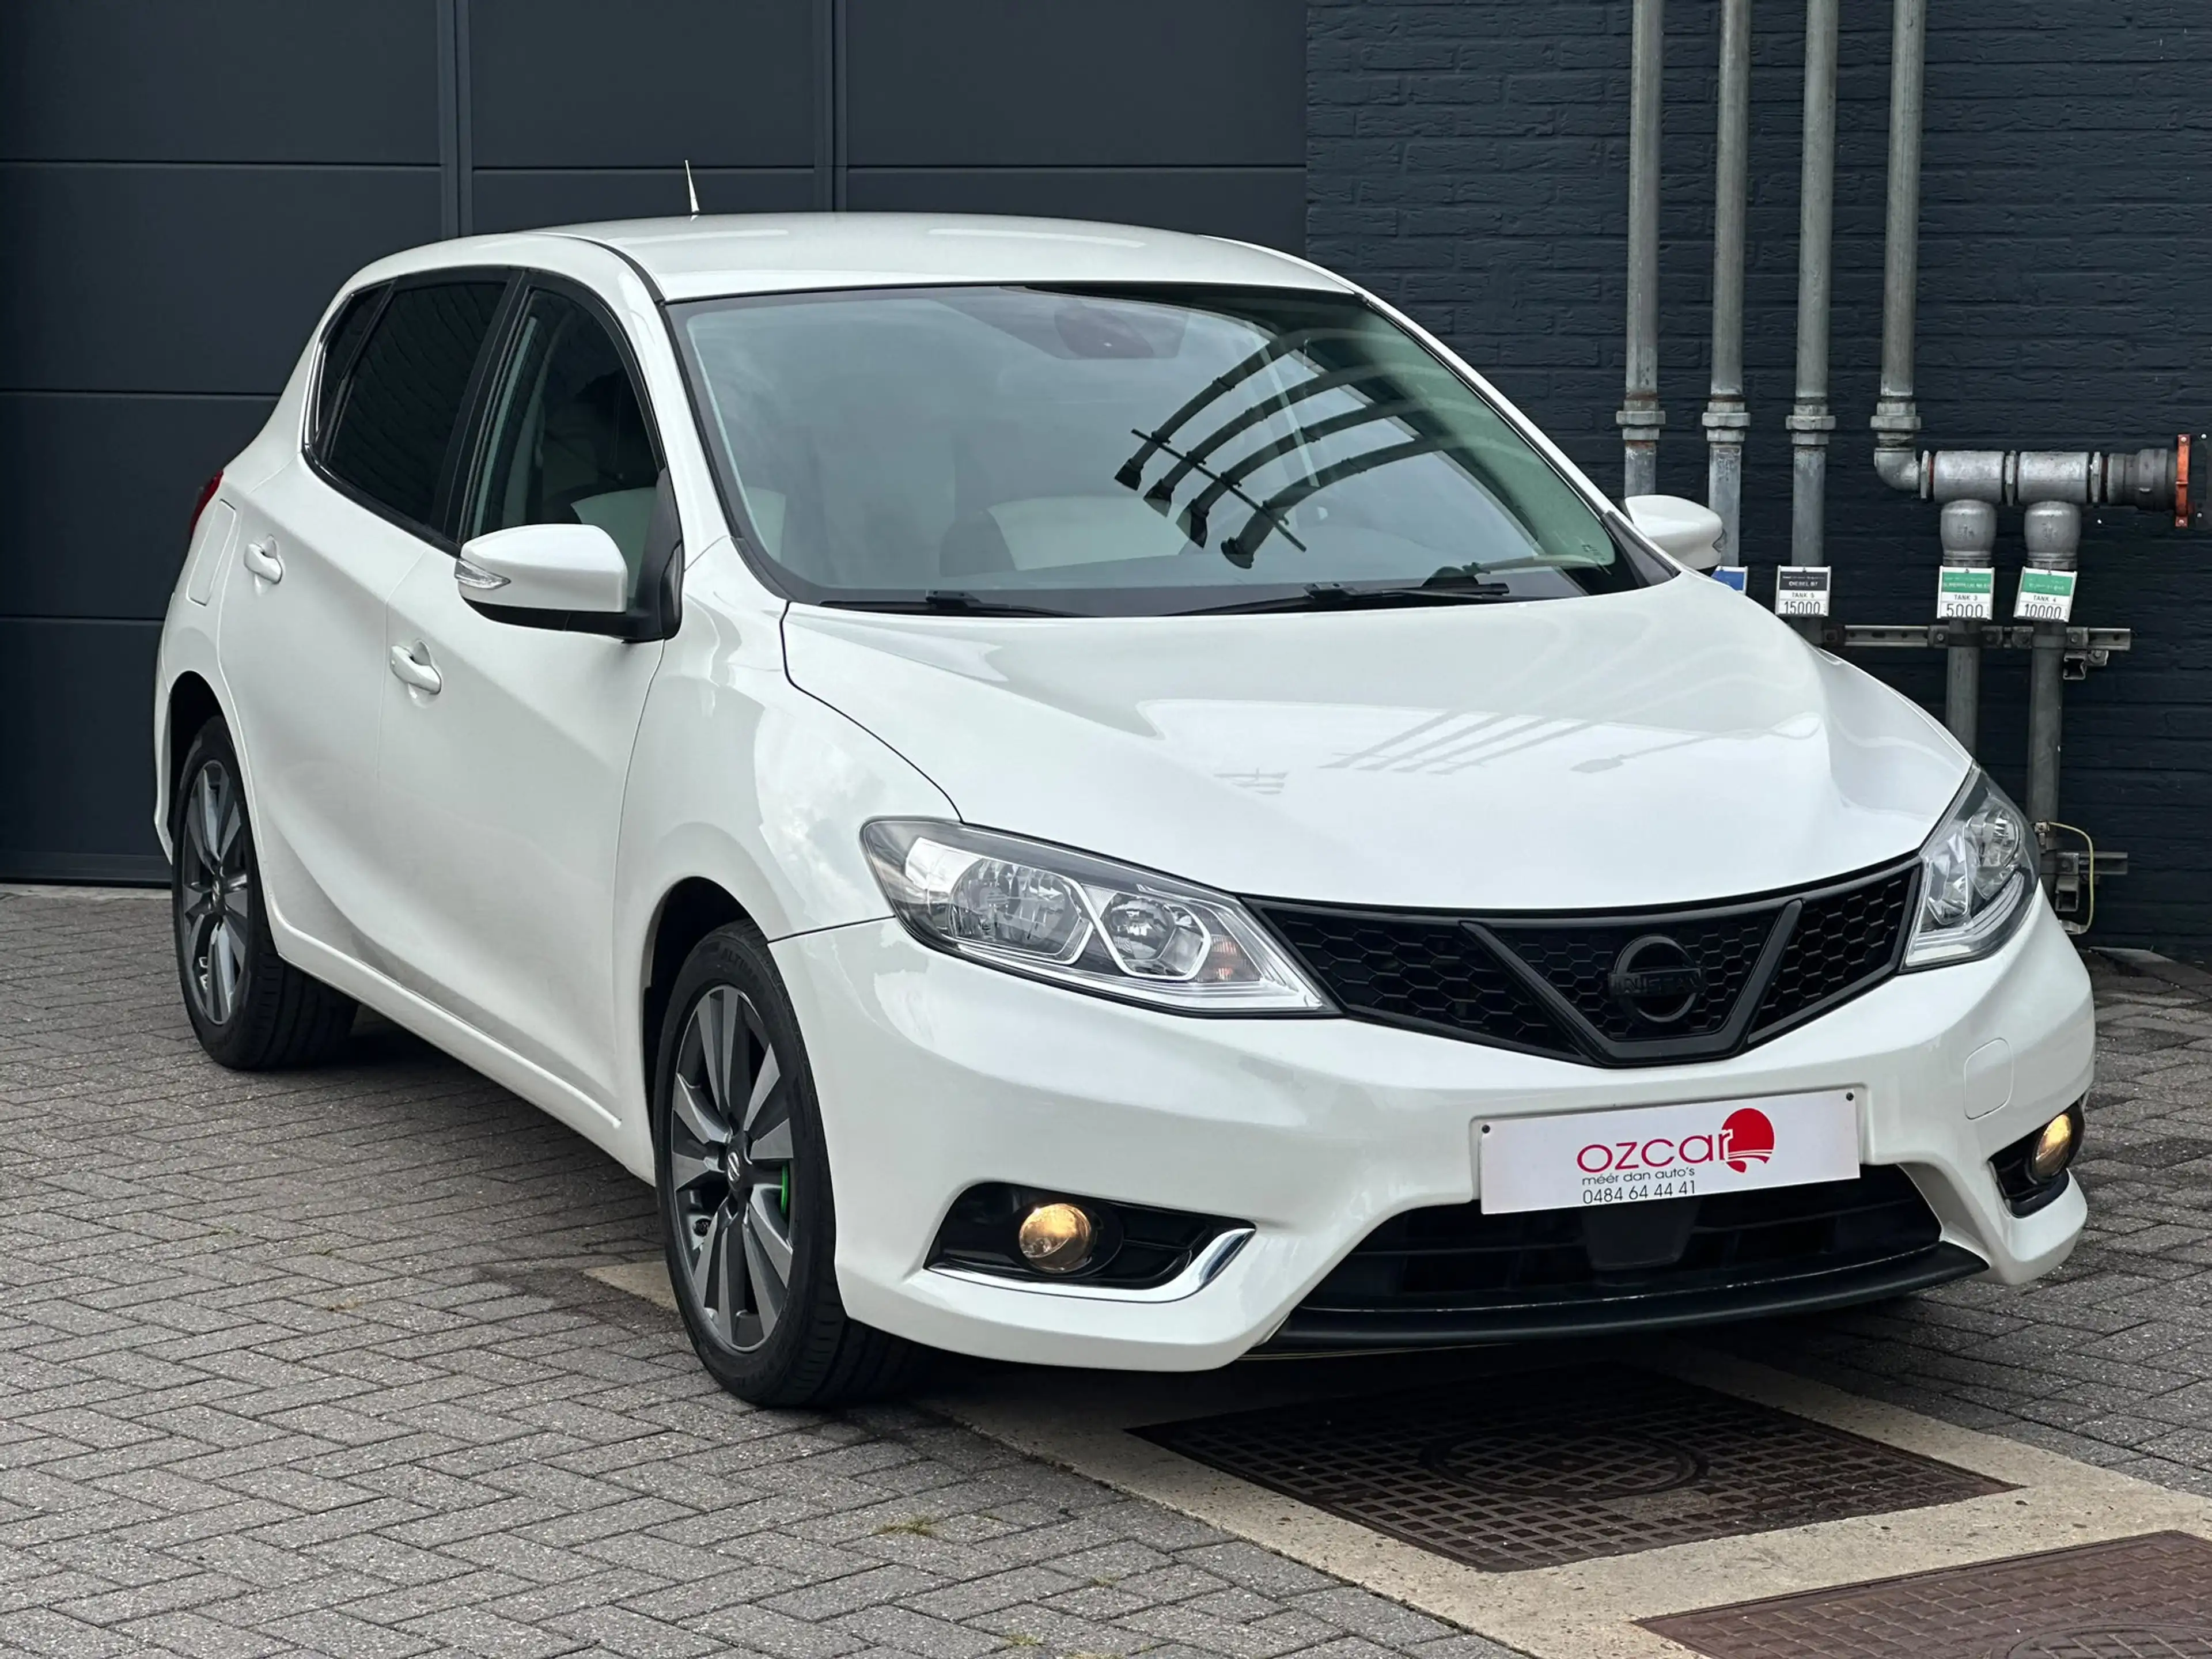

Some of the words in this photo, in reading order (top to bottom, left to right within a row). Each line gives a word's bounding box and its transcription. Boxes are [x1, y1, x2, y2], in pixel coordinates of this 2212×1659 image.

[1784, 601, 1820, 615] 15000
[1946, 603, 1983, 618] 5000
[2025, 603, 2062, 619] 10000
[1577, 1132, 1731, 1173] ozcar
[1623, 1170, 1651, 1182] dan
[1654, 1166, 1695, 1180] auto's
[1583, 1187, 1623, 1204] 0484
[1628, 1185, 1648, 1200] 64
[1653, 1183, 1673, 1196] 44
[1678, 1180, 1695, 1194] 41
